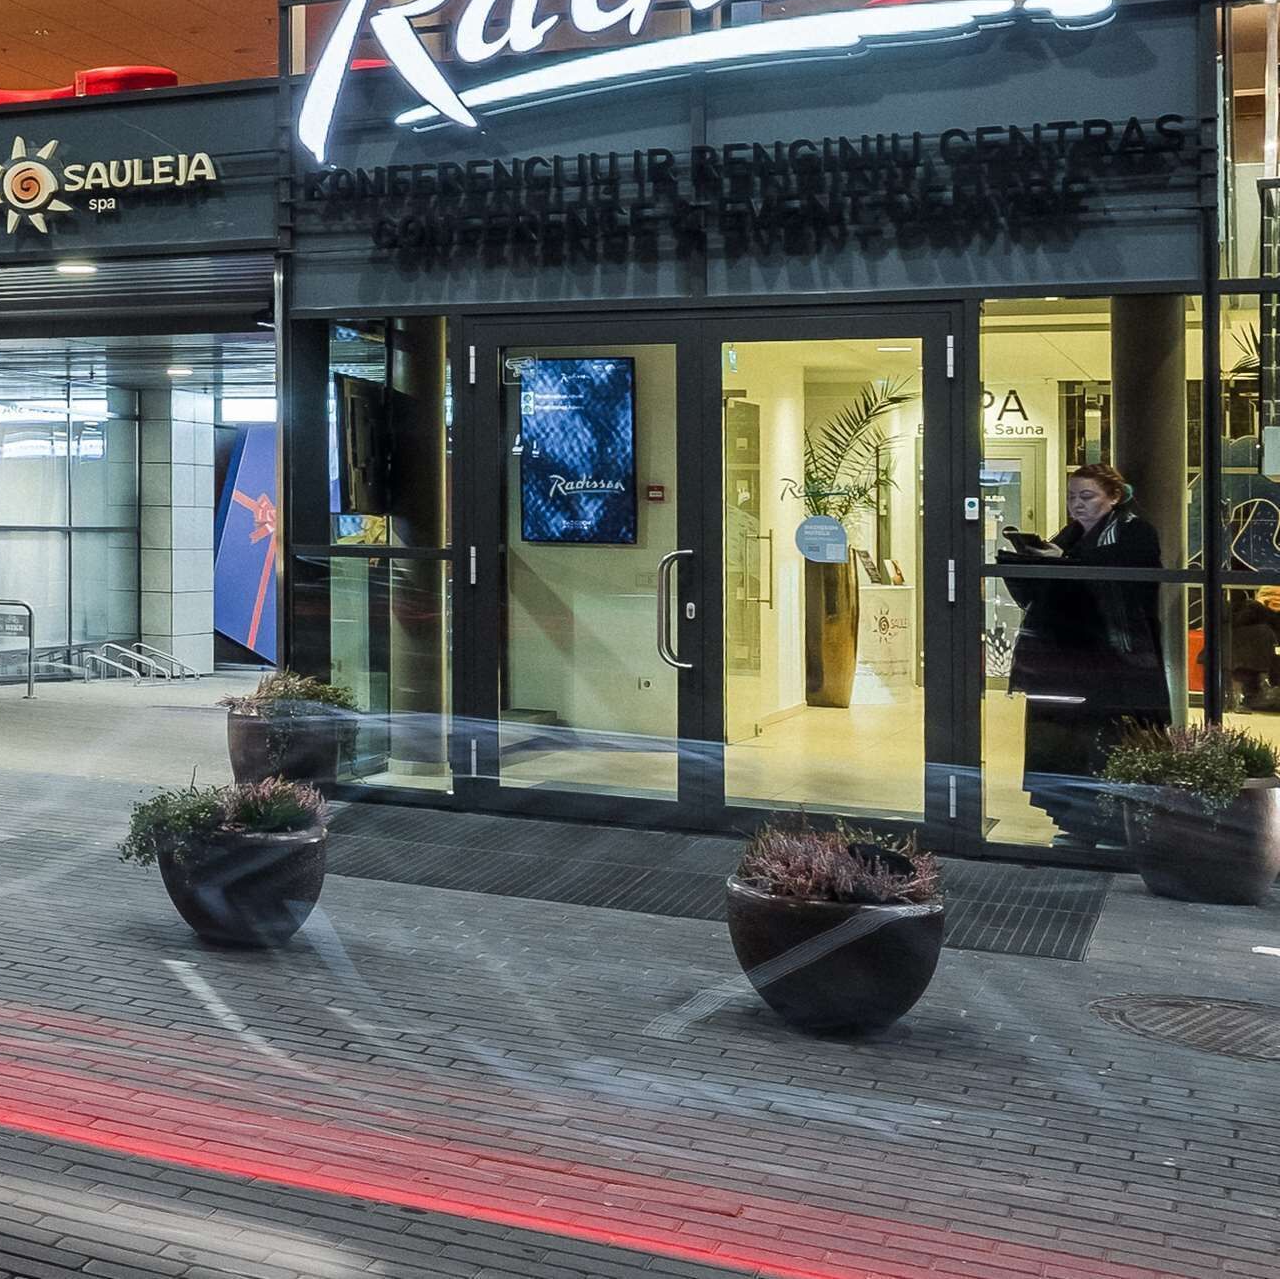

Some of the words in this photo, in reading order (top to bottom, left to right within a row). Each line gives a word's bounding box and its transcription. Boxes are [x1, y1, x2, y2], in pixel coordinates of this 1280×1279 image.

[63, 152, 217, 192] SAULEJA
[88, 196, 116, 213] spa
[982, 389, 1029, 421] PA
[995, 423, 1044, 435] Sauna
[549, 473, 625, 498] Radisson
